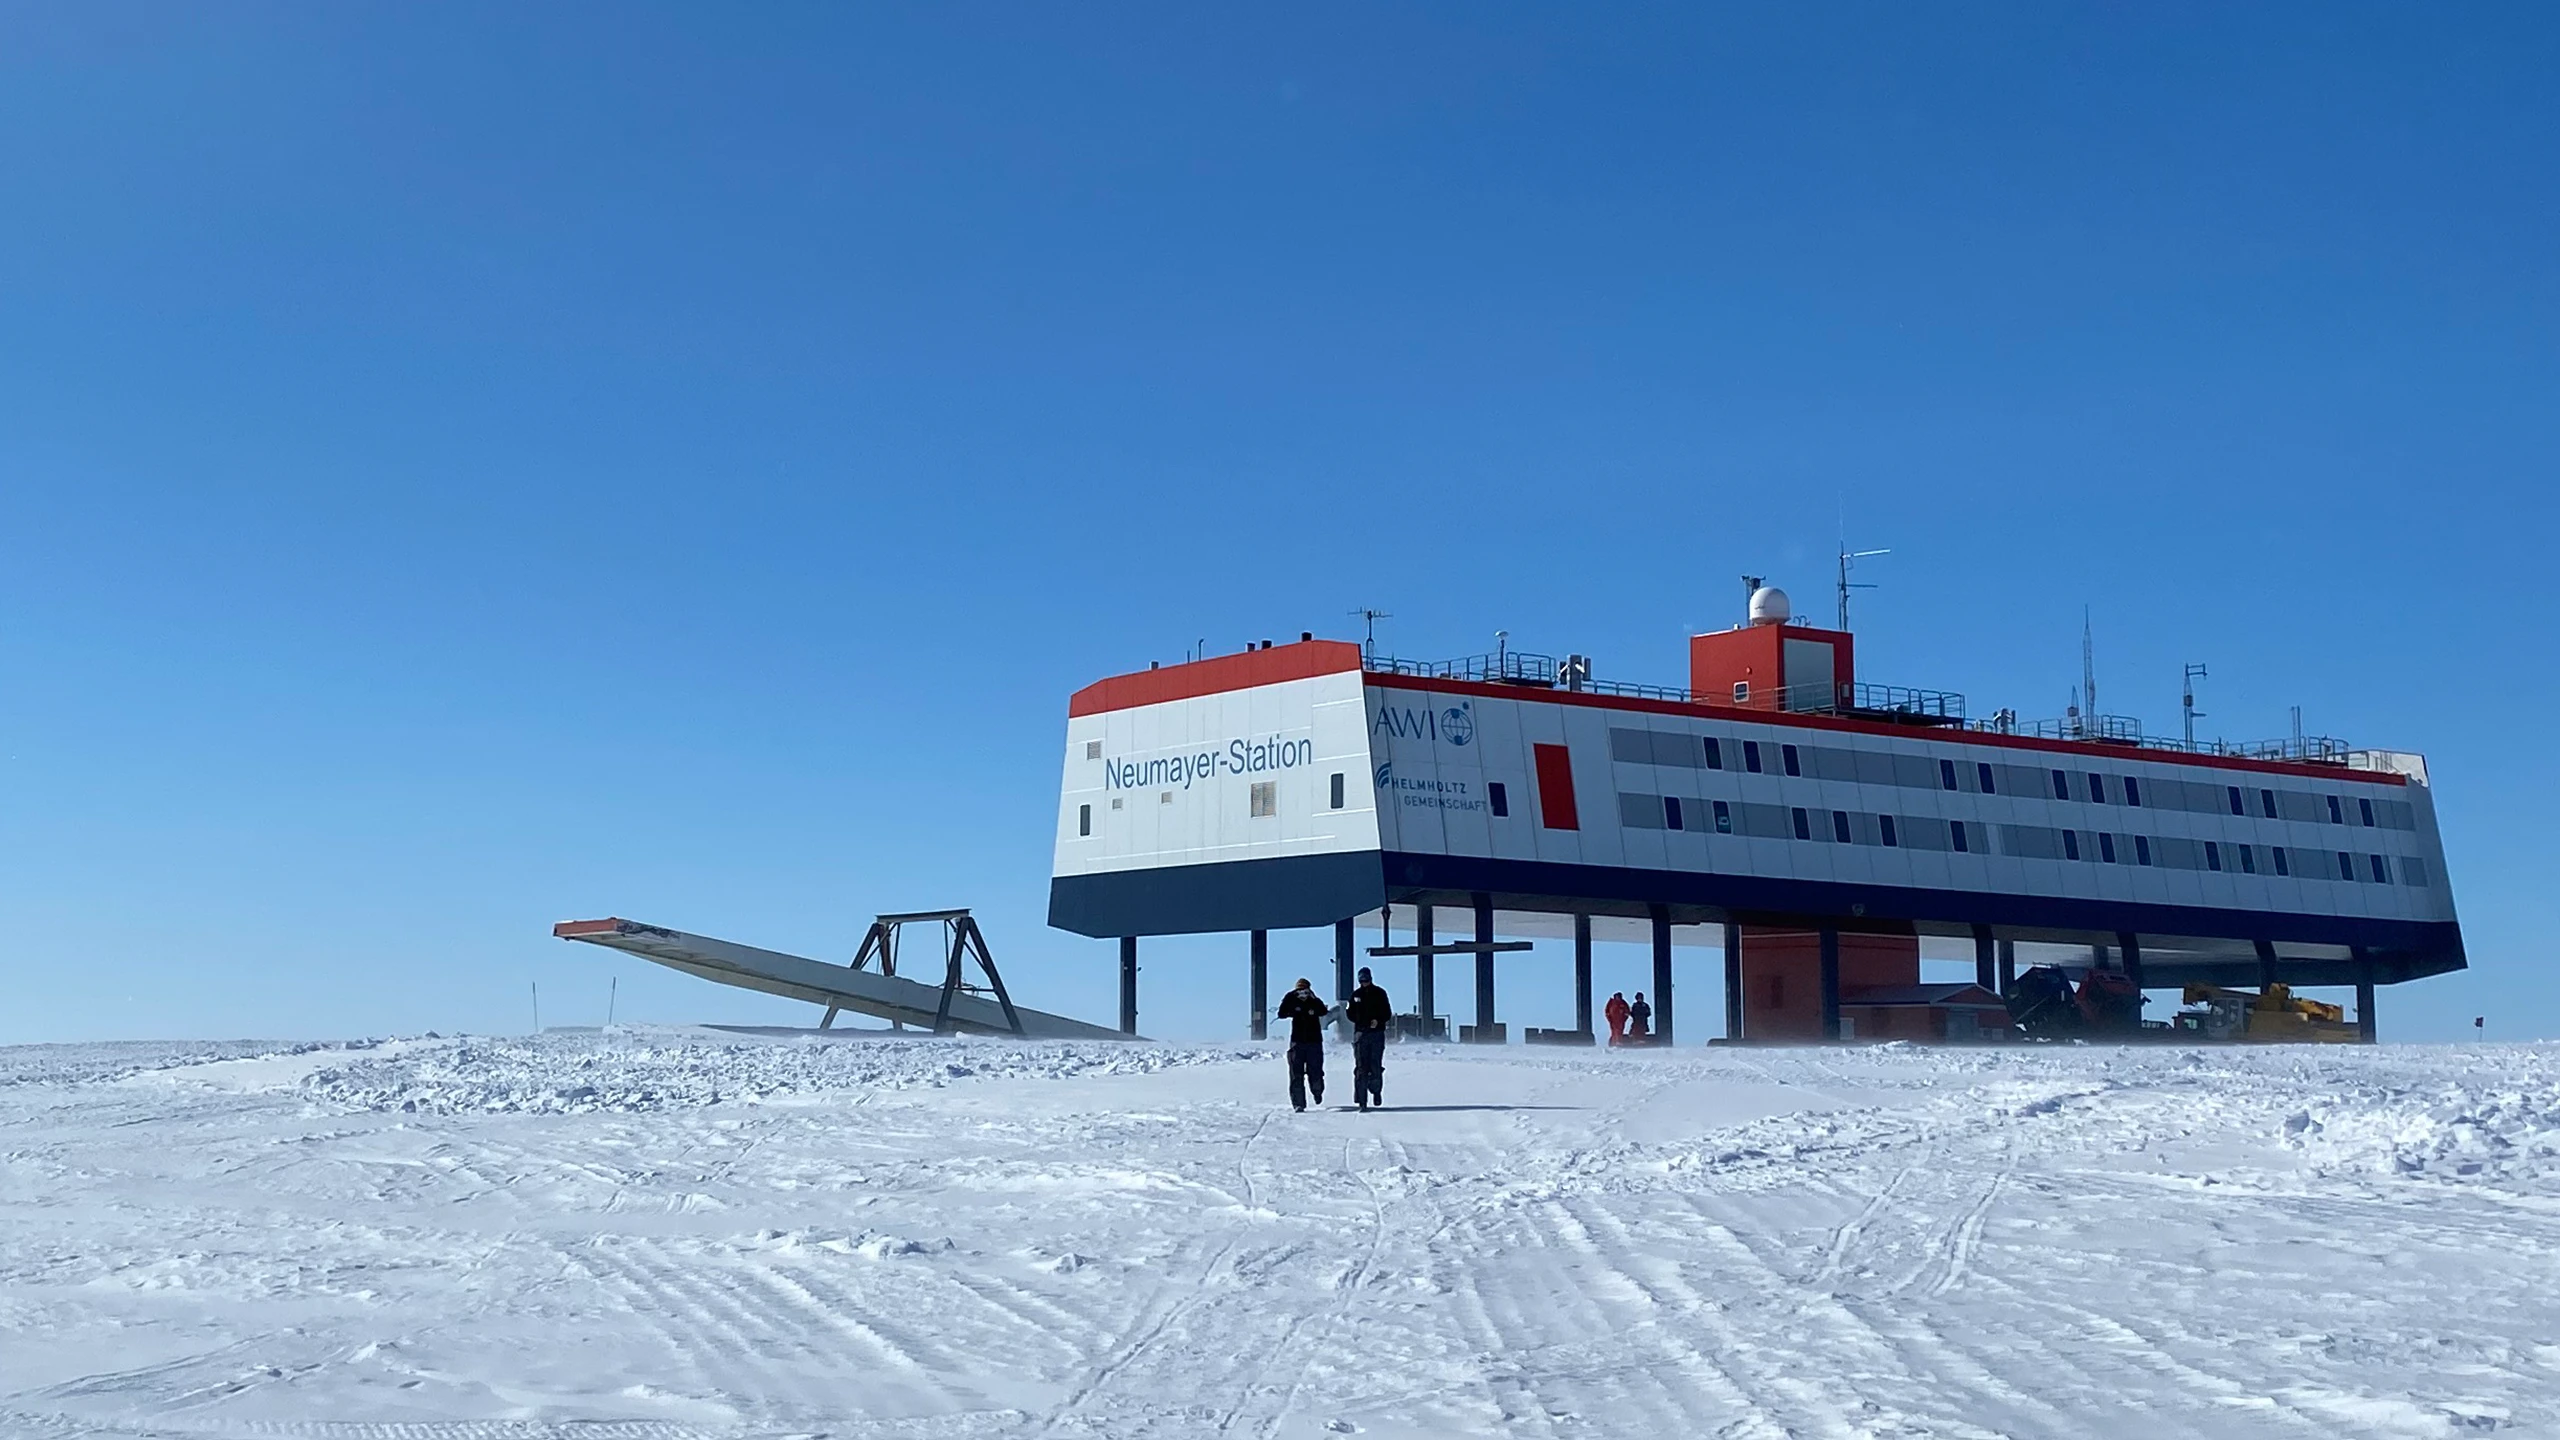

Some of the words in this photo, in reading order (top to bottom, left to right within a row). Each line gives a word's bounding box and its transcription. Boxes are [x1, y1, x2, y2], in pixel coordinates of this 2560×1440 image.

[1374, 706, 1436, 741] AWI
[1105, 733, 1312, 791] Neumayer-Station
[1391, 777, 1467, 794] HELMHOLTZ
[1404, 795, 1487, 812] GEMEINSCHAFT
